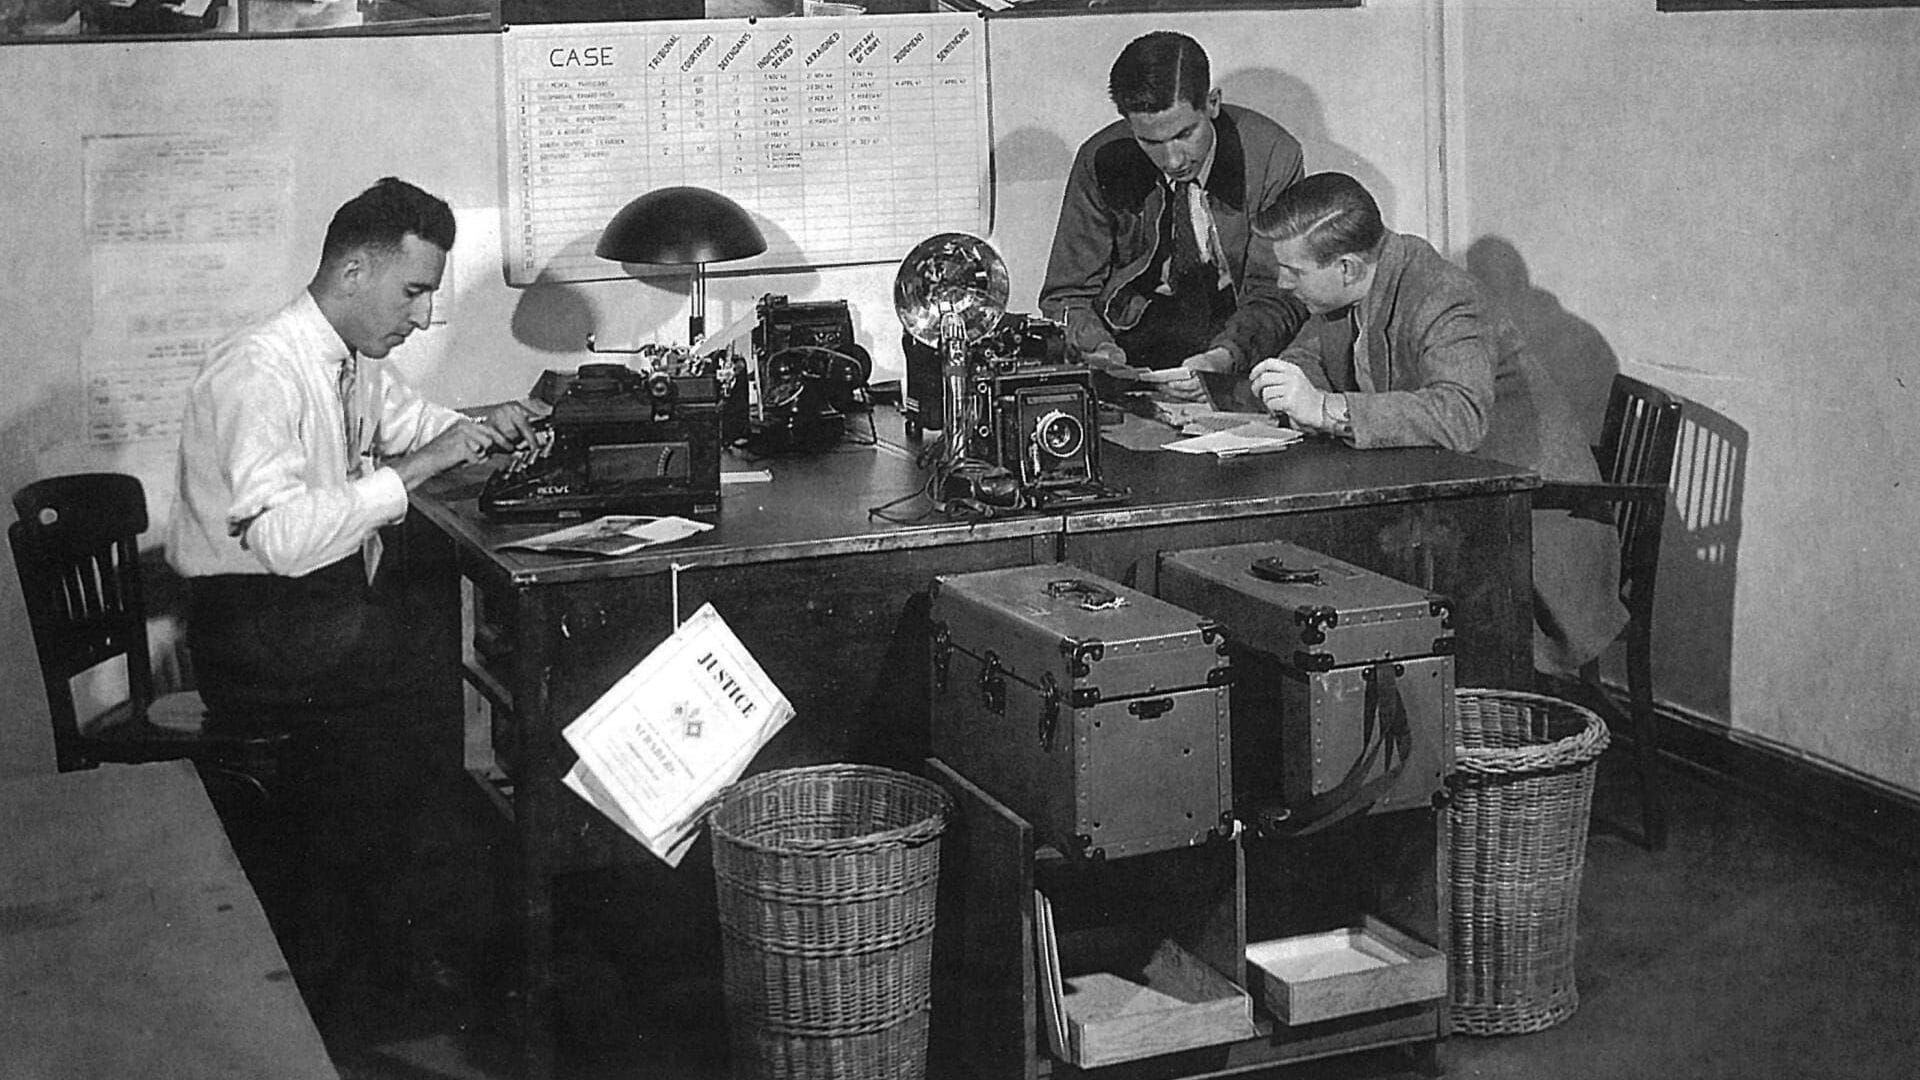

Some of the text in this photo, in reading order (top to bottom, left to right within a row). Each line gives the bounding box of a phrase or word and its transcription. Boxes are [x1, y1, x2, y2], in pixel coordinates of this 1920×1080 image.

[549, 46, 614, 67] CASE
[648, 33, 681, 70] TRIBUNAL
[680, 34, 715, 73] COURTROOM
[717, 32, 752, 72] DEFENDANTS
[756, 33, 794, 70] INDICTMENT
[771, 47, 795, 70] SERVED
[803, 31, 841, 68] ARRAIGNED
[848, 30, 876, 59] FIRST DAY
[893, 32, 925, 63] JUDGMENT
[936, 27, 970, 62] SENTENCING
[697, 652, 758, 719] JUSTICE
